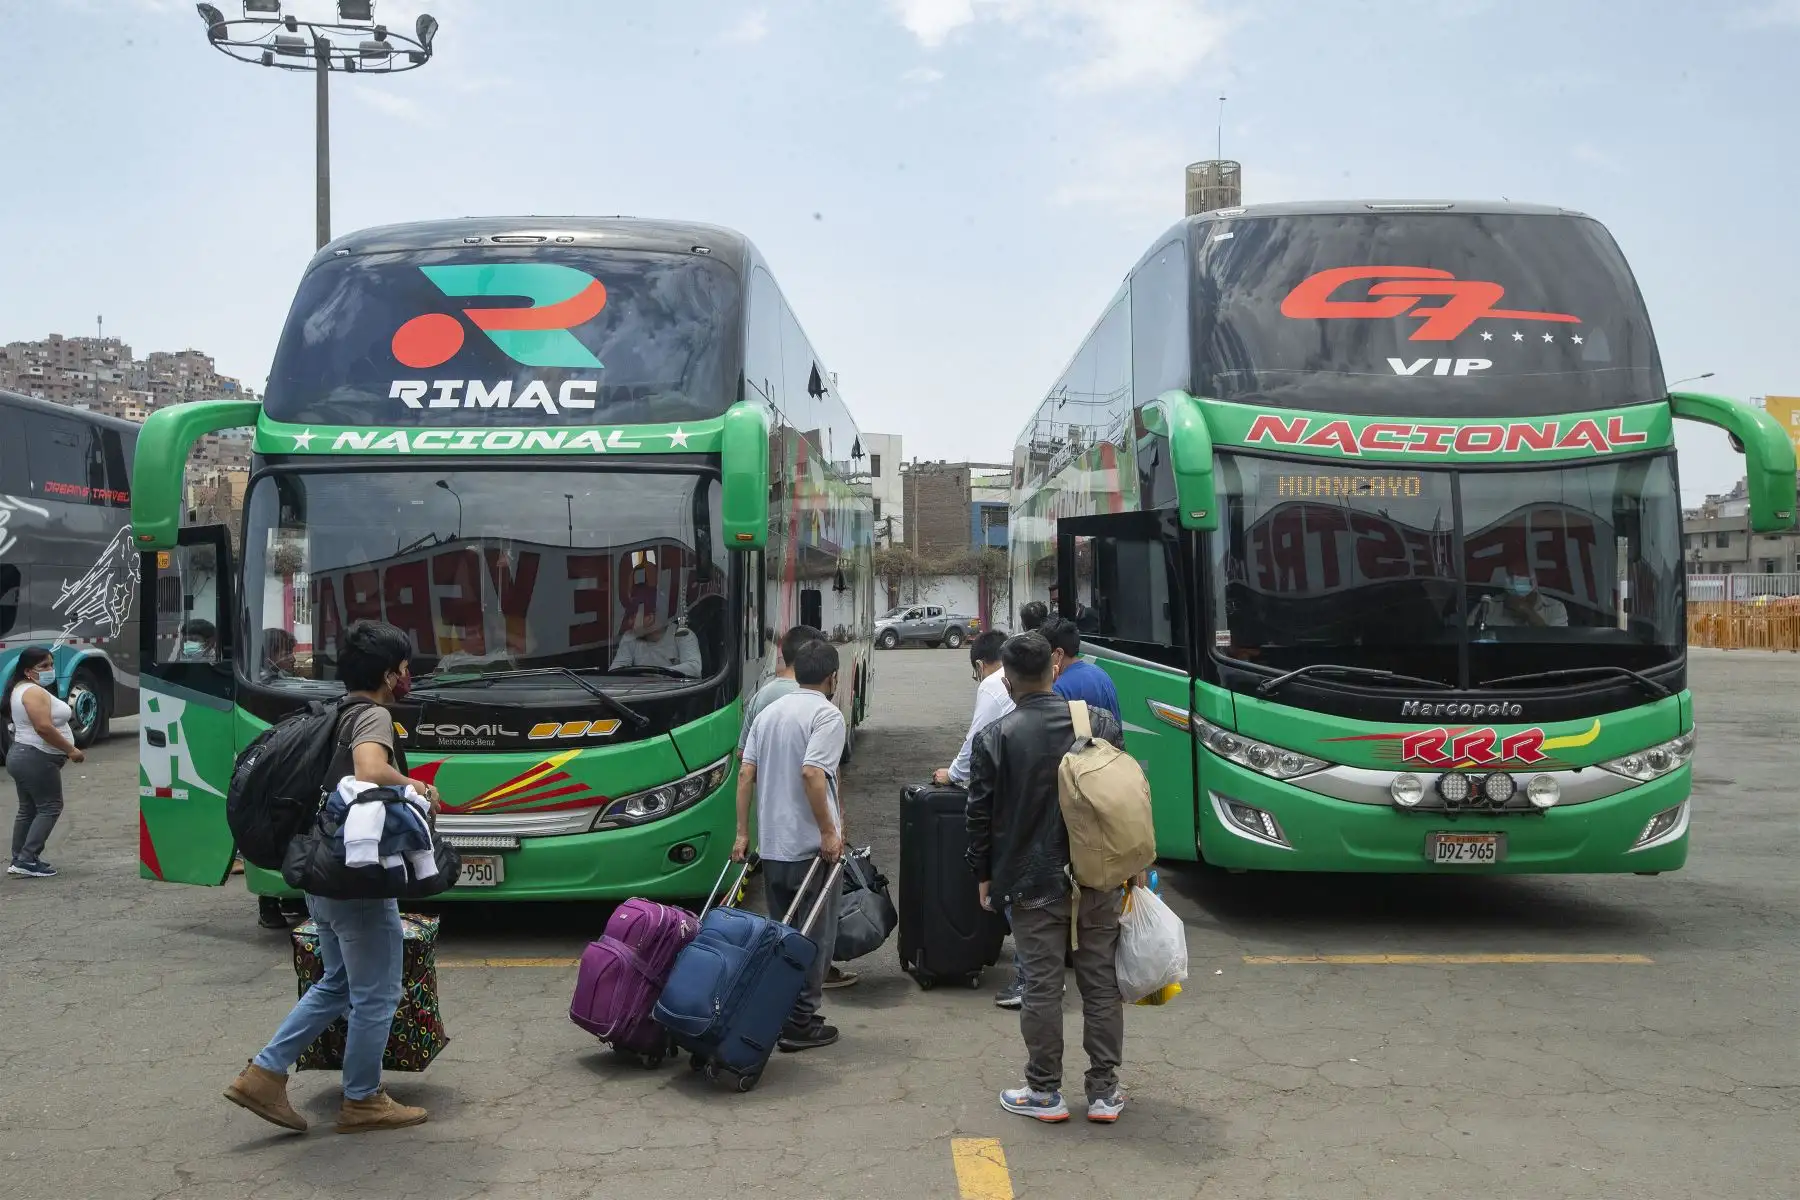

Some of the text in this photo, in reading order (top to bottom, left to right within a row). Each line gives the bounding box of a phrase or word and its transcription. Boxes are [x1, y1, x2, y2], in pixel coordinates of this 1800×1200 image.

[1280, 265, 1582, 341] G7
[1386, 357, 1493, 376] VIP
[388, 379, 598, 415] RIMAC
[331, 430, 642, 453] NACIONAL
[1243, 414, 1648, 456] NACIONAL
[92, 487, 130, 503] TRAVEL
[1279, 476, 1421, 497] HUANCAYO
[1401, 701, 1523, 717] Marcopolo
[415, 723, 519, 736] COMIL
[438, 737, 496, 746] Mercedes-Benz
[1402, 727, 1550, 764] RRR
[1438, 842, 1494, 860] D9Z-965
[461, 864, 493, 881] -950
